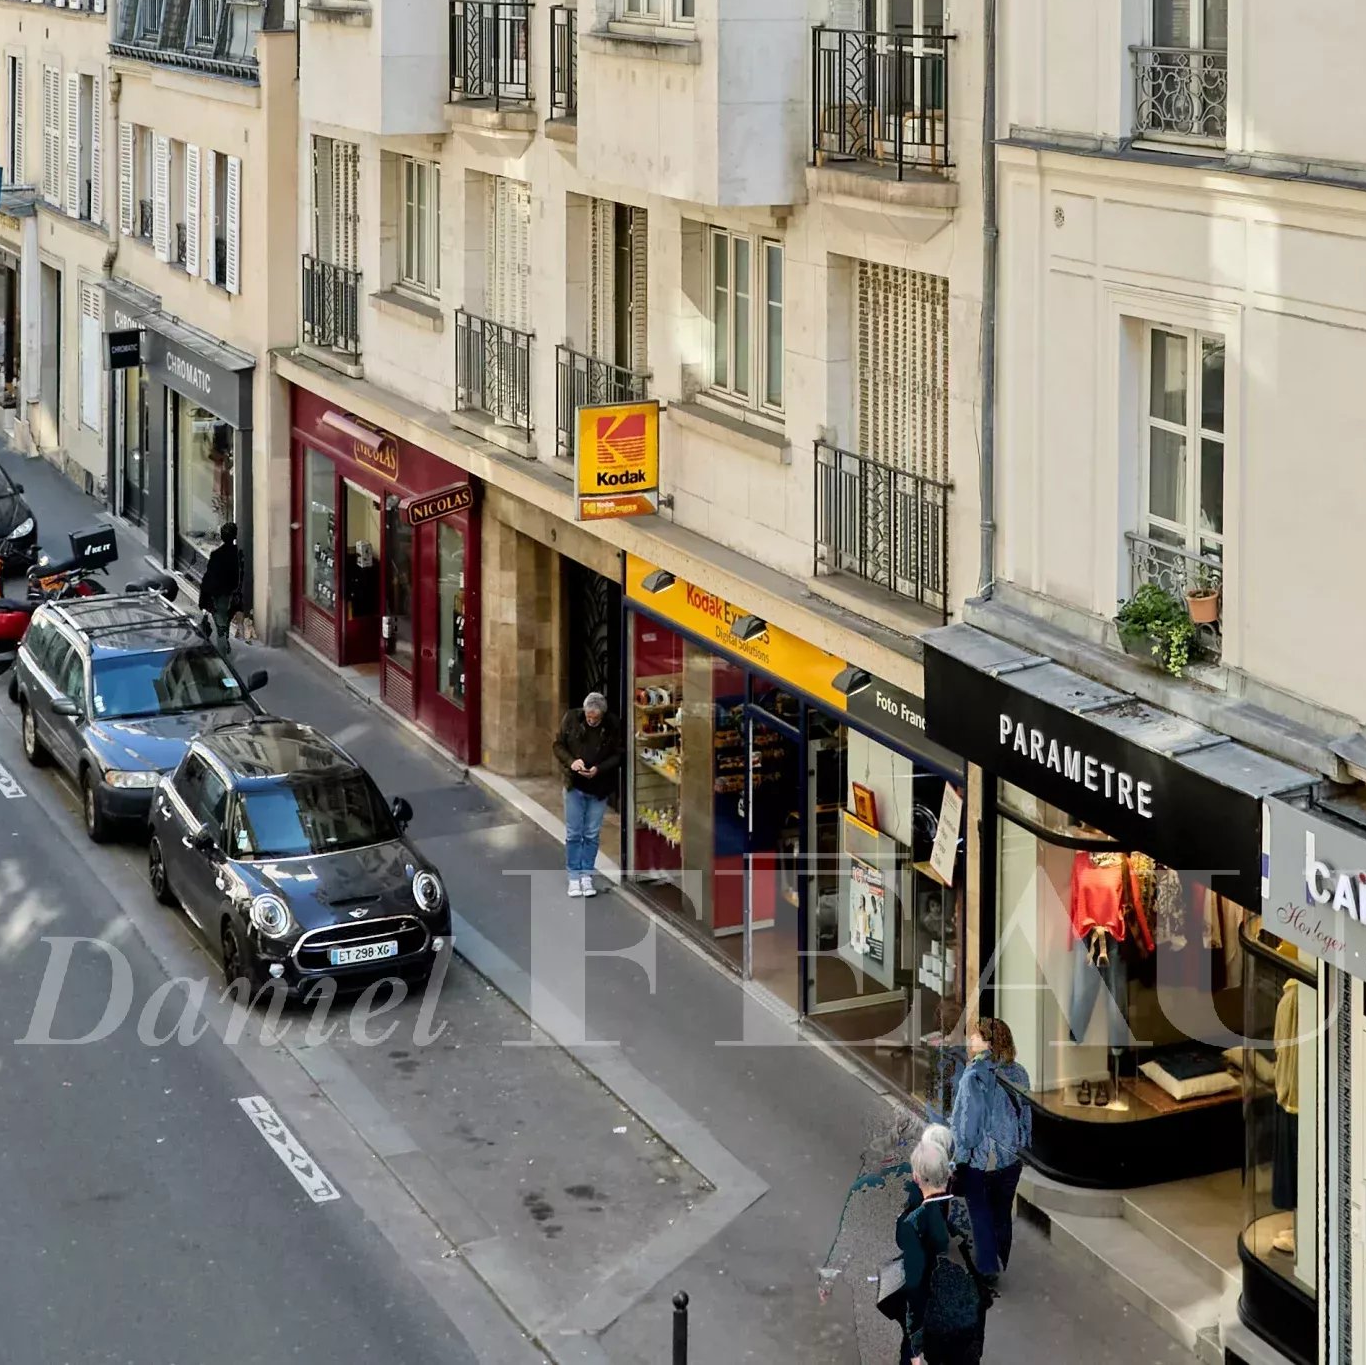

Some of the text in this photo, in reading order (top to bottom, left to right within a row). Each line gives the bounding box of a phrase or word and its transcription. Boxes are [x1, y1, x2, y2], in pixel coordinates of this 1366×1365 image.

[166, 351, 211, 394] CHROMATIC
[596, 469, 646, 486] Kodak
[413, 490, 470, 520] NICOLAS
[686, 583, 723, 621] Kodak
[876, 690, 898, 715] Foto
[999, 713, 1153, 819] PARAMETRE
